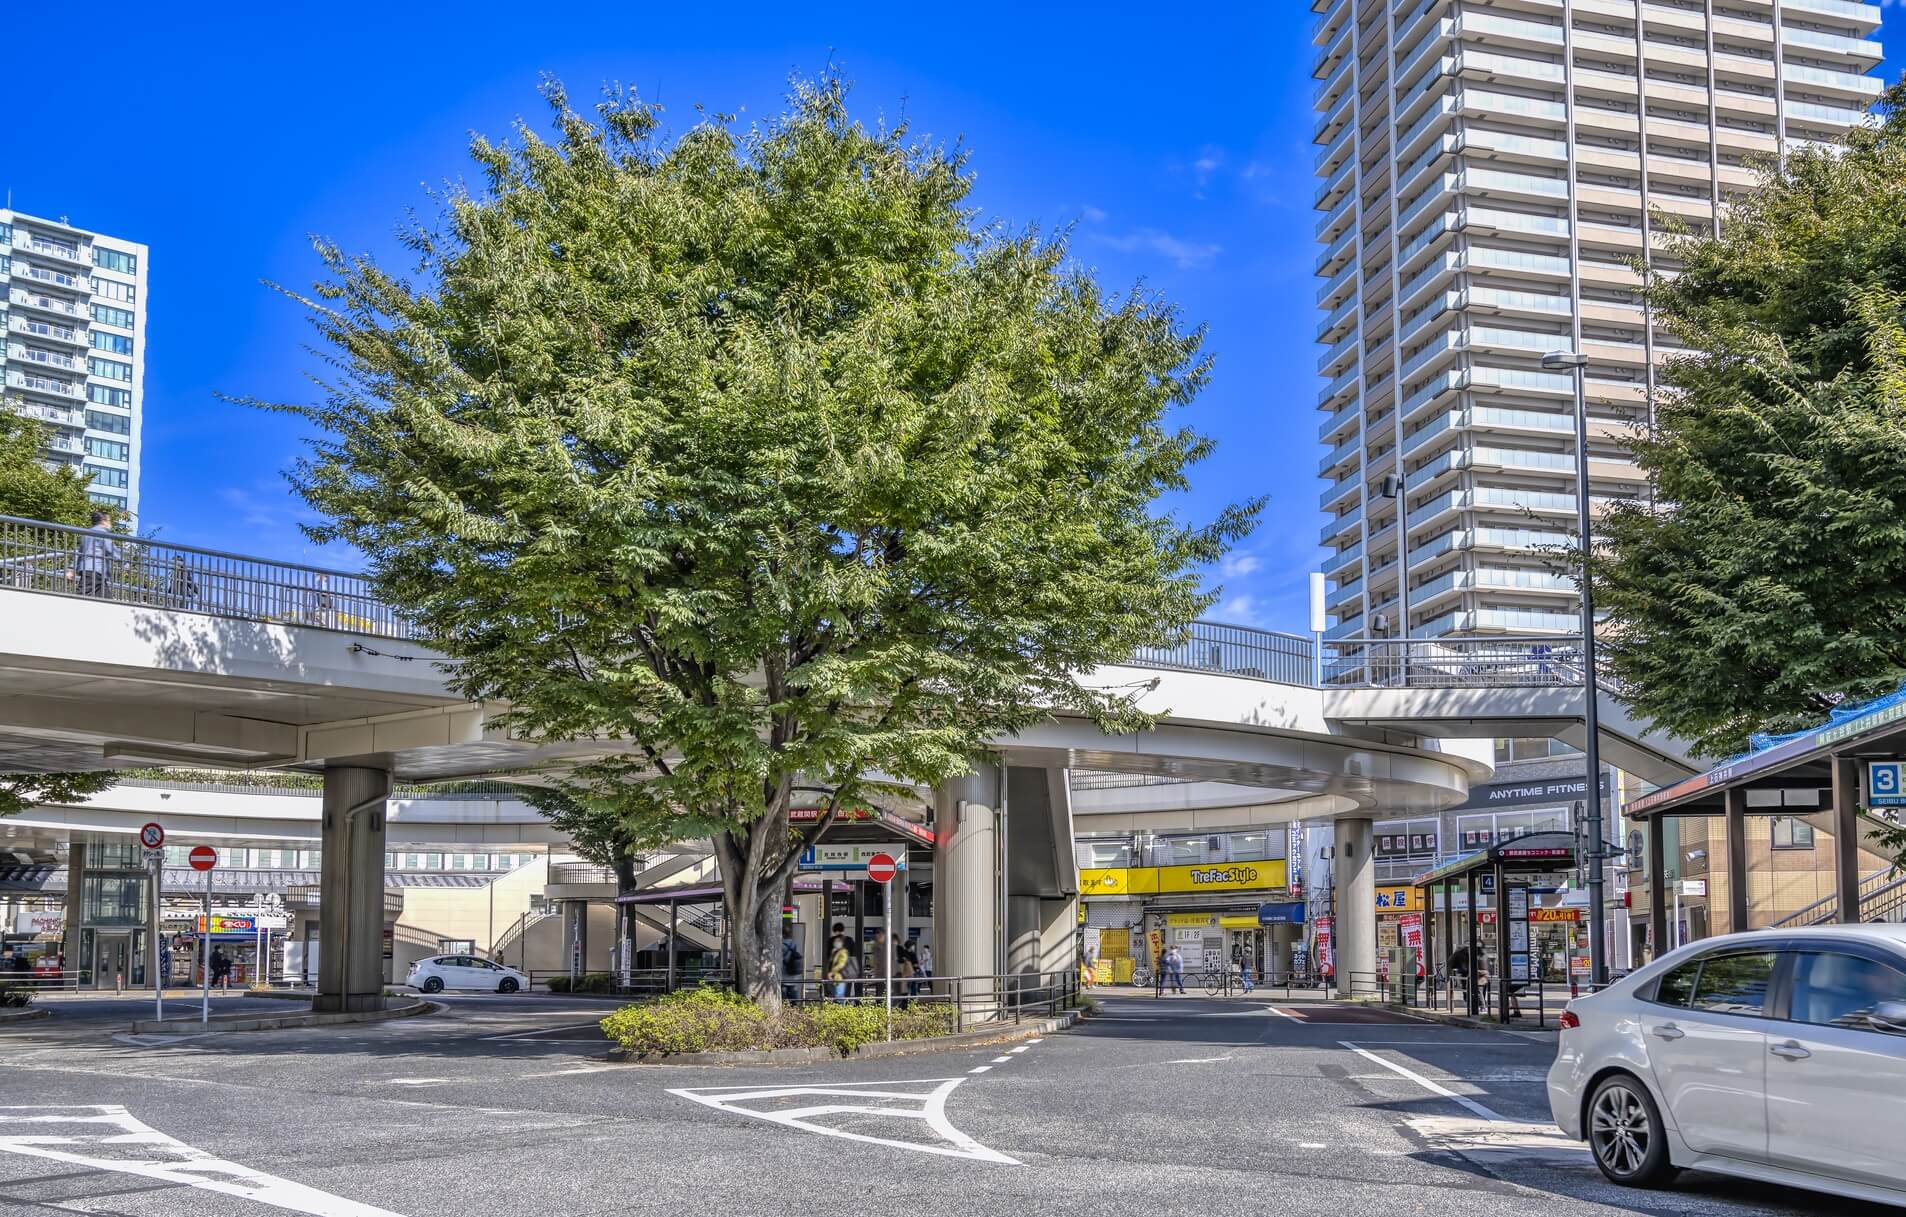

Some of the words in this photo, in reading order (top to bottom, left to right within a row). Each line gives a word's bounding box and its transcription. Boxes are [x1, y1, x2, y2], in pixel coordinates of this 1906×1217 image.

[1877, 769, 1894, 790] 3
[1489, 786, 1543, 800] ANYTIME
[1547, 782, 1605, 794] FITNES
[1191, 867, 1257, 884] TreFacStyle
[1485, 877, 1492, 886] 4
[1376, 891, 1407, 907] 松屋
[1529, 926, 1541, 980] FamilyMart
